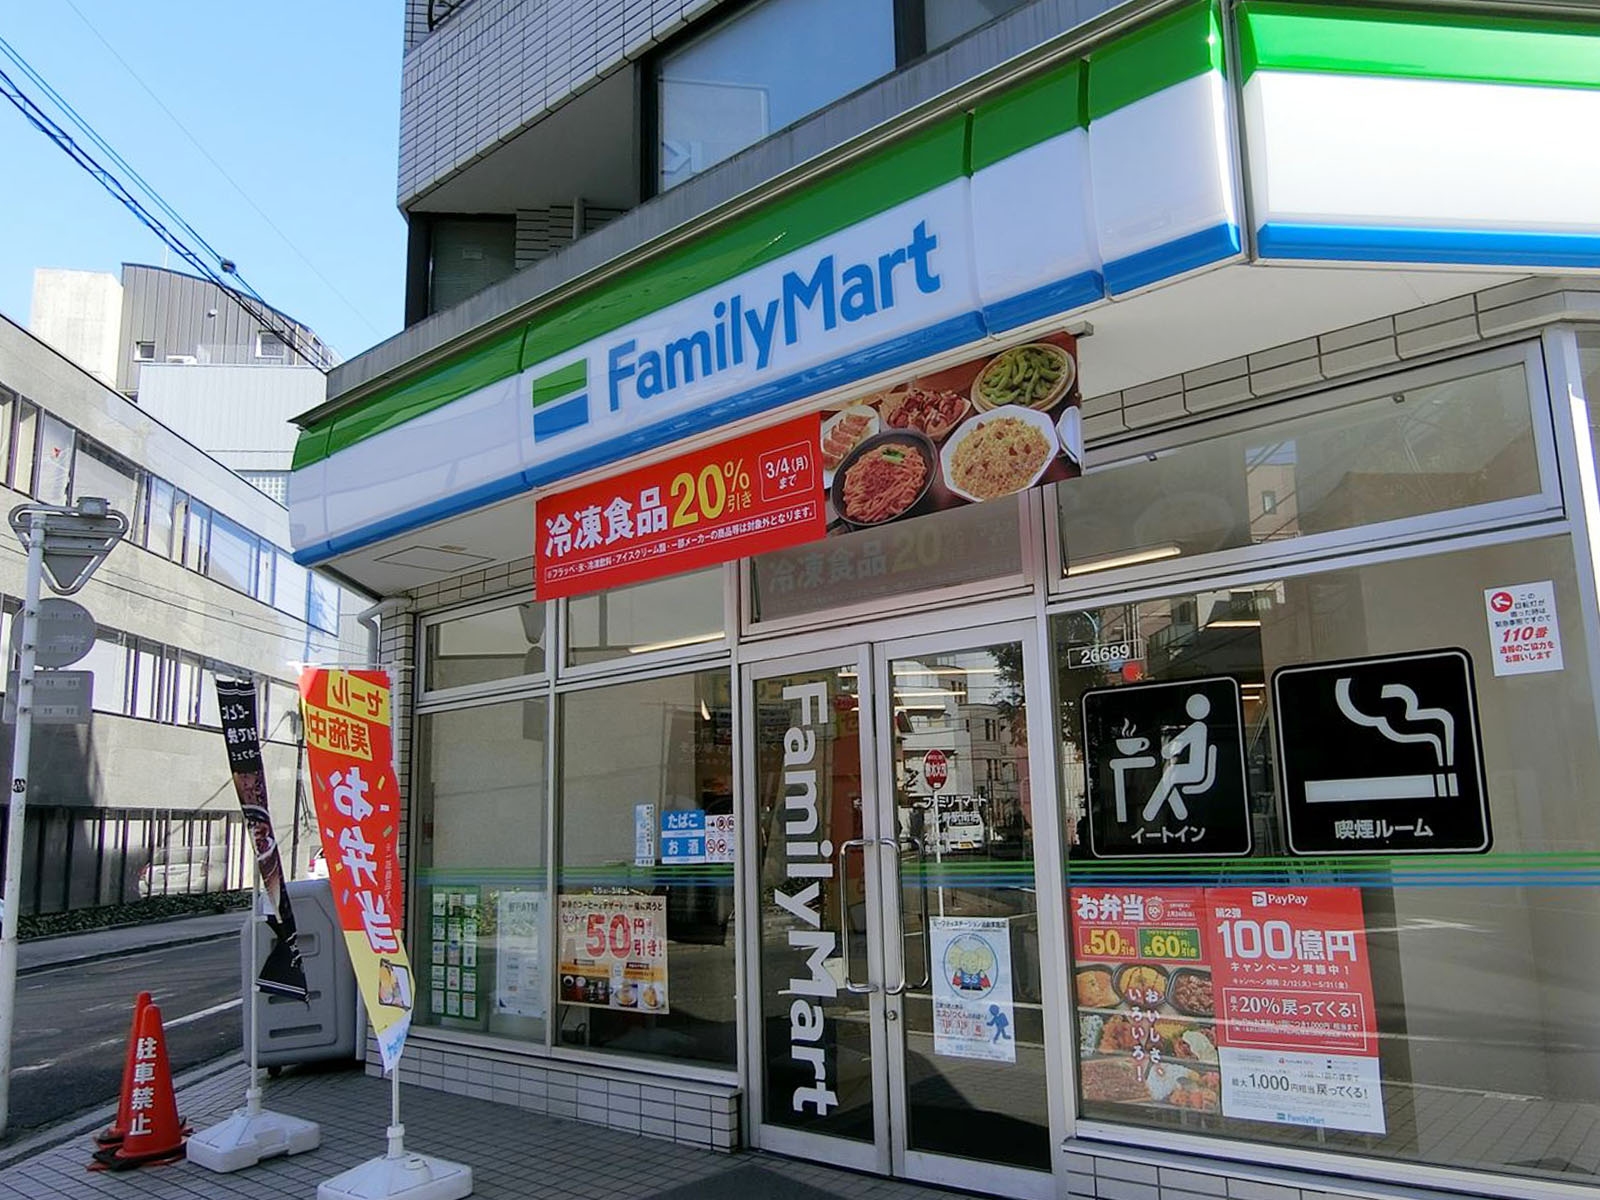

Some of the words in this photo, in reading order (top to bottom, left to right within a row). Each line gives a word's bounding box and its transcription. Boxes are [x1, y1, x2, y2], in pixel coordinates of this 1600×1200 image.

[608, 219, 941, 413] FamilyMart
[765, 455, 808, 479] 3/4(月)
[779, 474, 797, 489] まで
[545, 486, 667, 557] 冷凍食品
[671, 458, 750, 528] 20%
[1520, 592, 1536, 601] この
[1503, 626, 1549, 643] 110番
[1081, 644, 1130, 664] 26689
[1504, 650, 1553, 663] お願いします
[667, 812, 699, 829] たばこ
[1334, 817, 1434, 840] 喫煙ルーム
[1131, 825, 1206, 844] イートイン
[667, 838, 700, 855] お酒
[774, 681, 839, 1117] FamilyMart
[1077, 893, 1144, 921] お弁当
[1268, 893, 1308, 906] PayPay
[1215, 908, 1242, 918] 第2弾
[585, 912, 632, 958] 50
[1217, 919, 1357, 962] 100億円
[1128, 988, 1145, 1082] いろいろ!
[129, 1036, 158, 1136] 駐車禁止
[1287, 1112, 1325, 1125] FamilyMart
